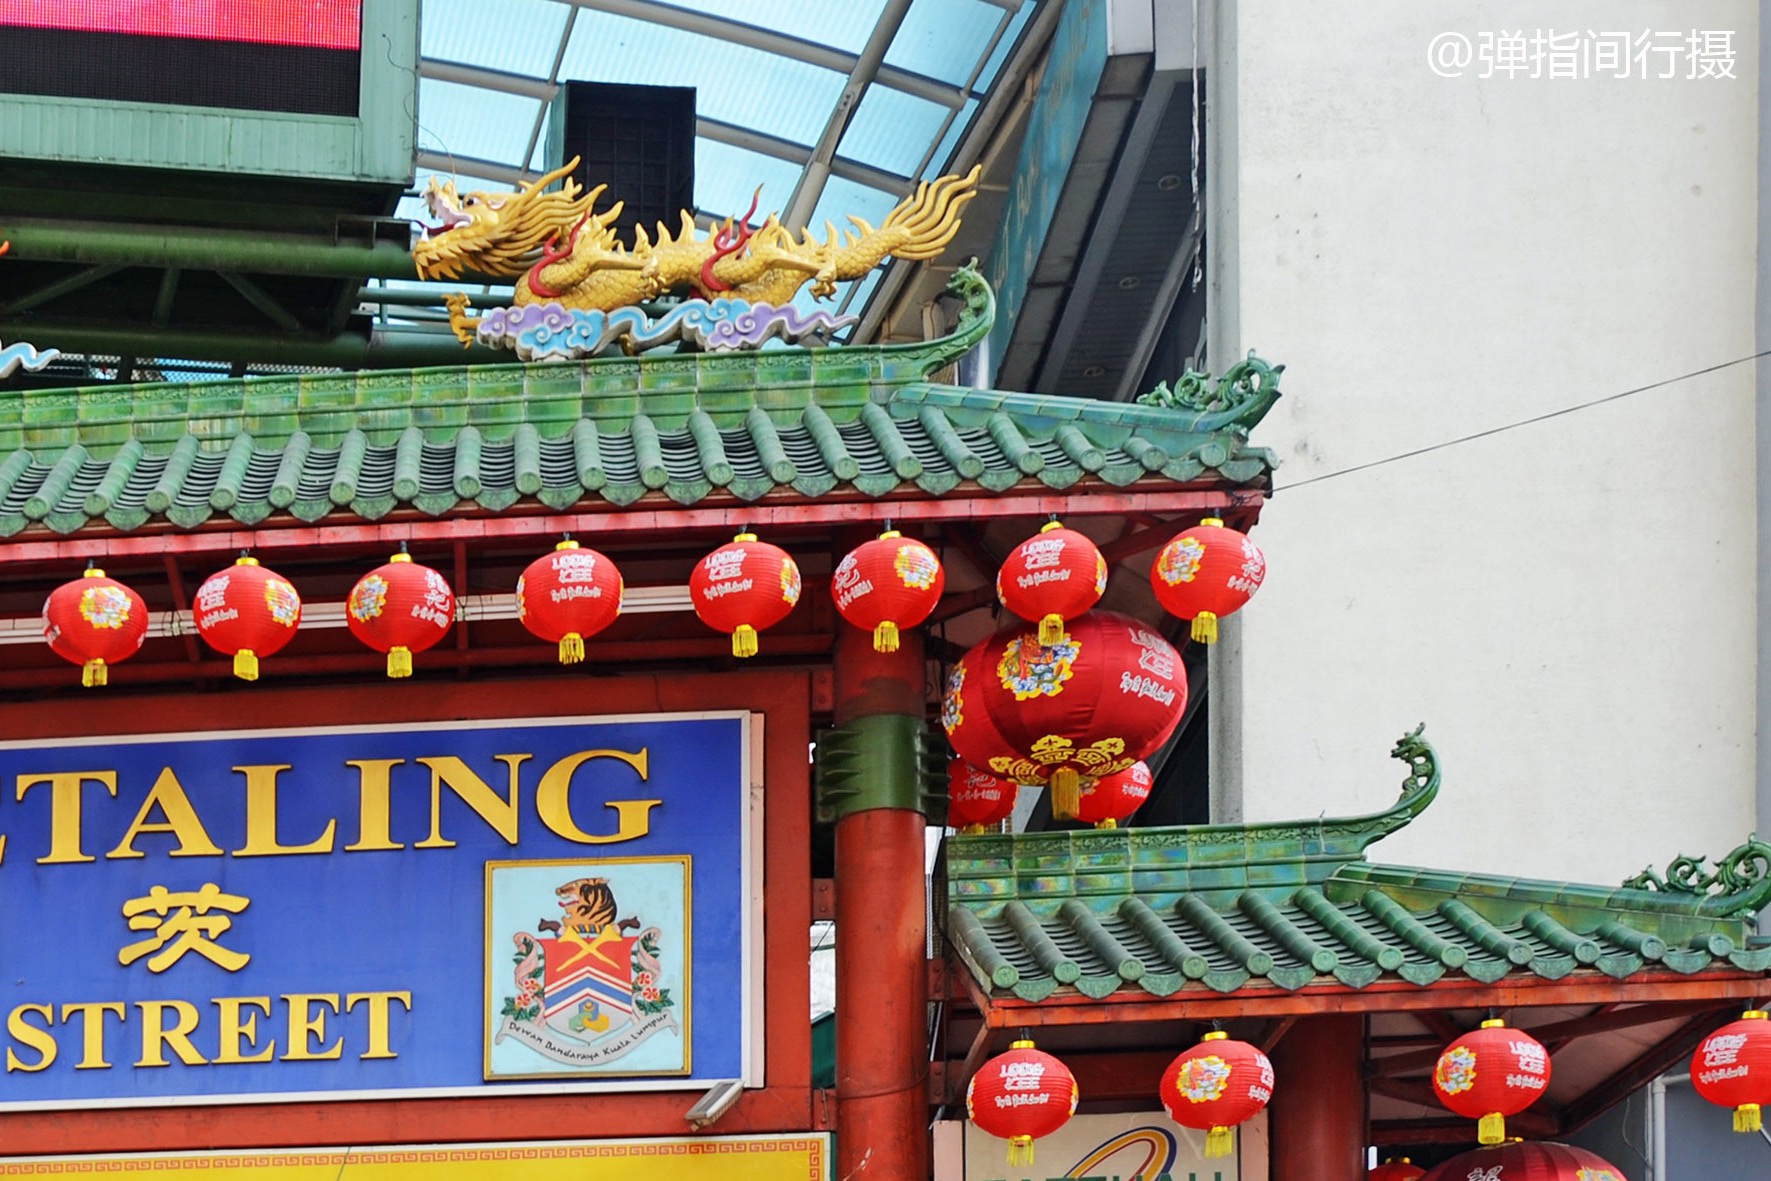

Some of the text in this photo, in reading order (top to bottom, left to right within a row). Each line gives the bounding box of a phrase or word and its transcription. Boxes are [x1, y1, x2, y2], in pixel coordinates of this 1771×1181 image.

[5, 990, 412, 1073] STREET
[508, 1021, 544, 1044] Dewan
[544, 1041, 600, 1061] Bandaraya
[603, 1039, 631, 1056] Kuala
